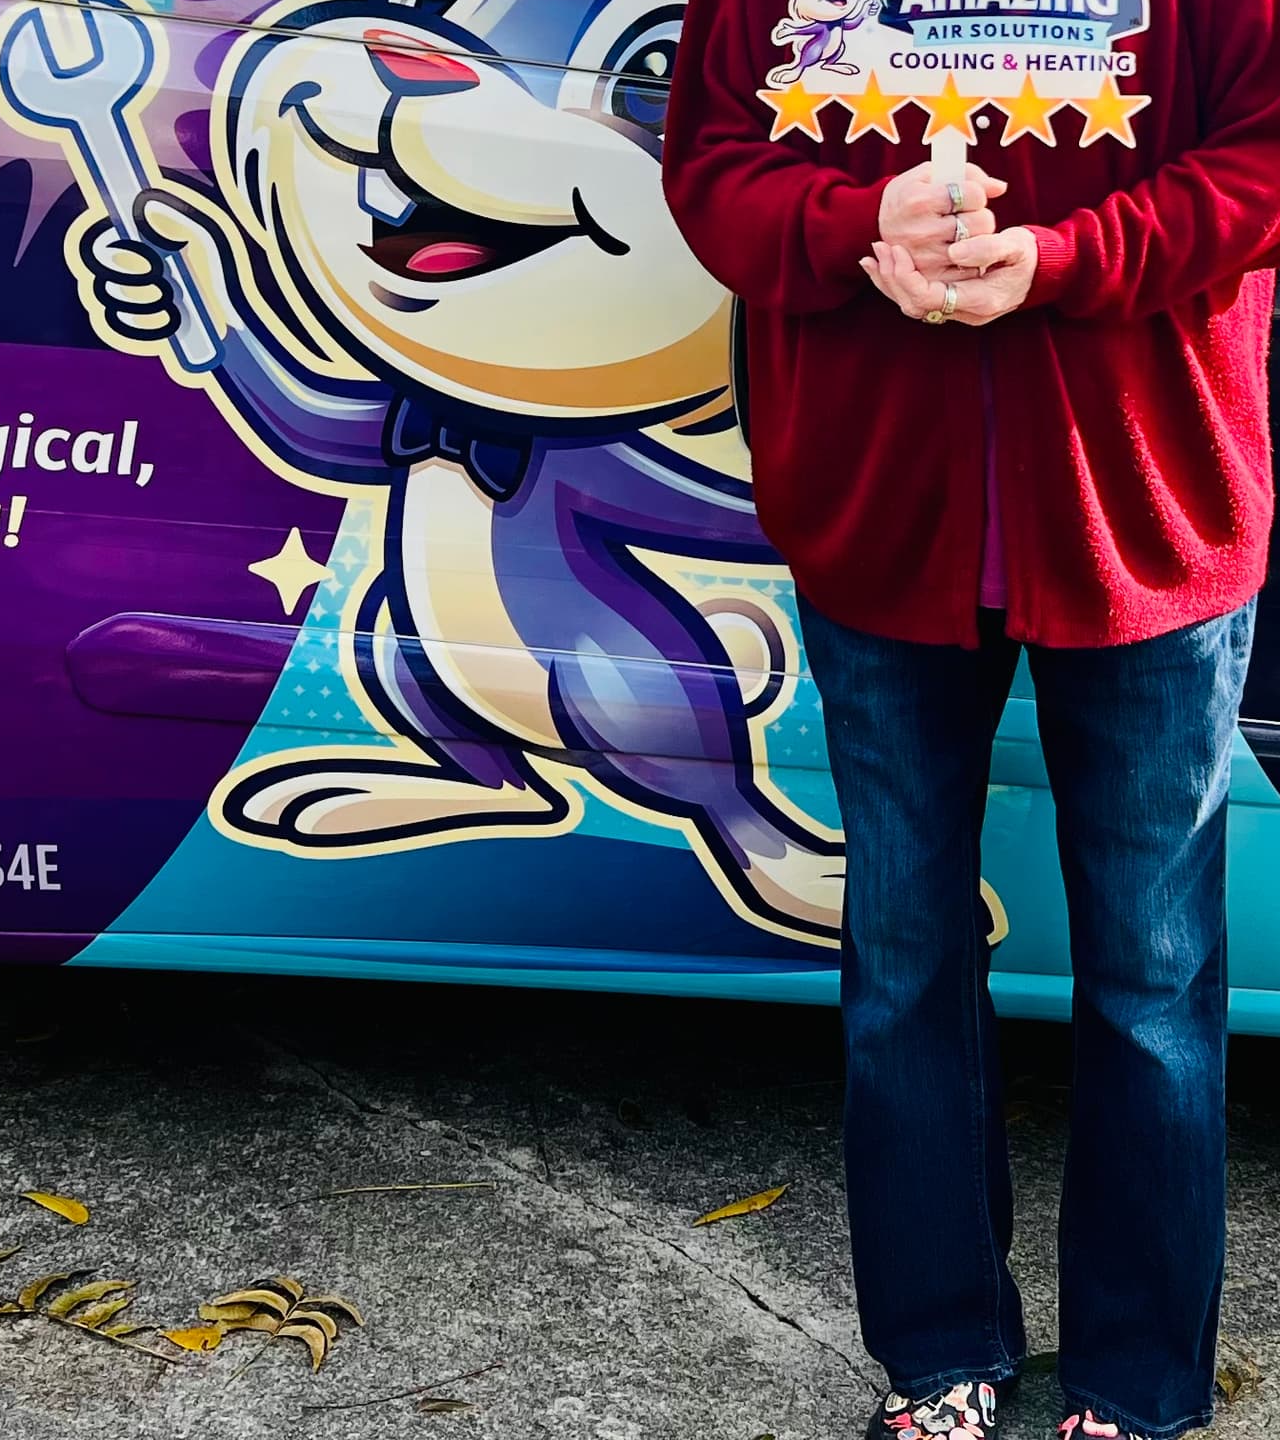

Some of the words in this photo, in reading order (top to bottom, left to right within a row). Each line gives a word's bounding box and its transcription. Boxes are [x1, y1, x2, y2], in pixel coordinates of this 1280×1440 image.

[927, 25, 963, 41] AIR
[970, 23, 1095, 42] SOLUTIONS
[889, 52, 995, 71] COOLING
[1002, 53, 1019, 71] &
[1025, 54, 1131, 72] HEATING
